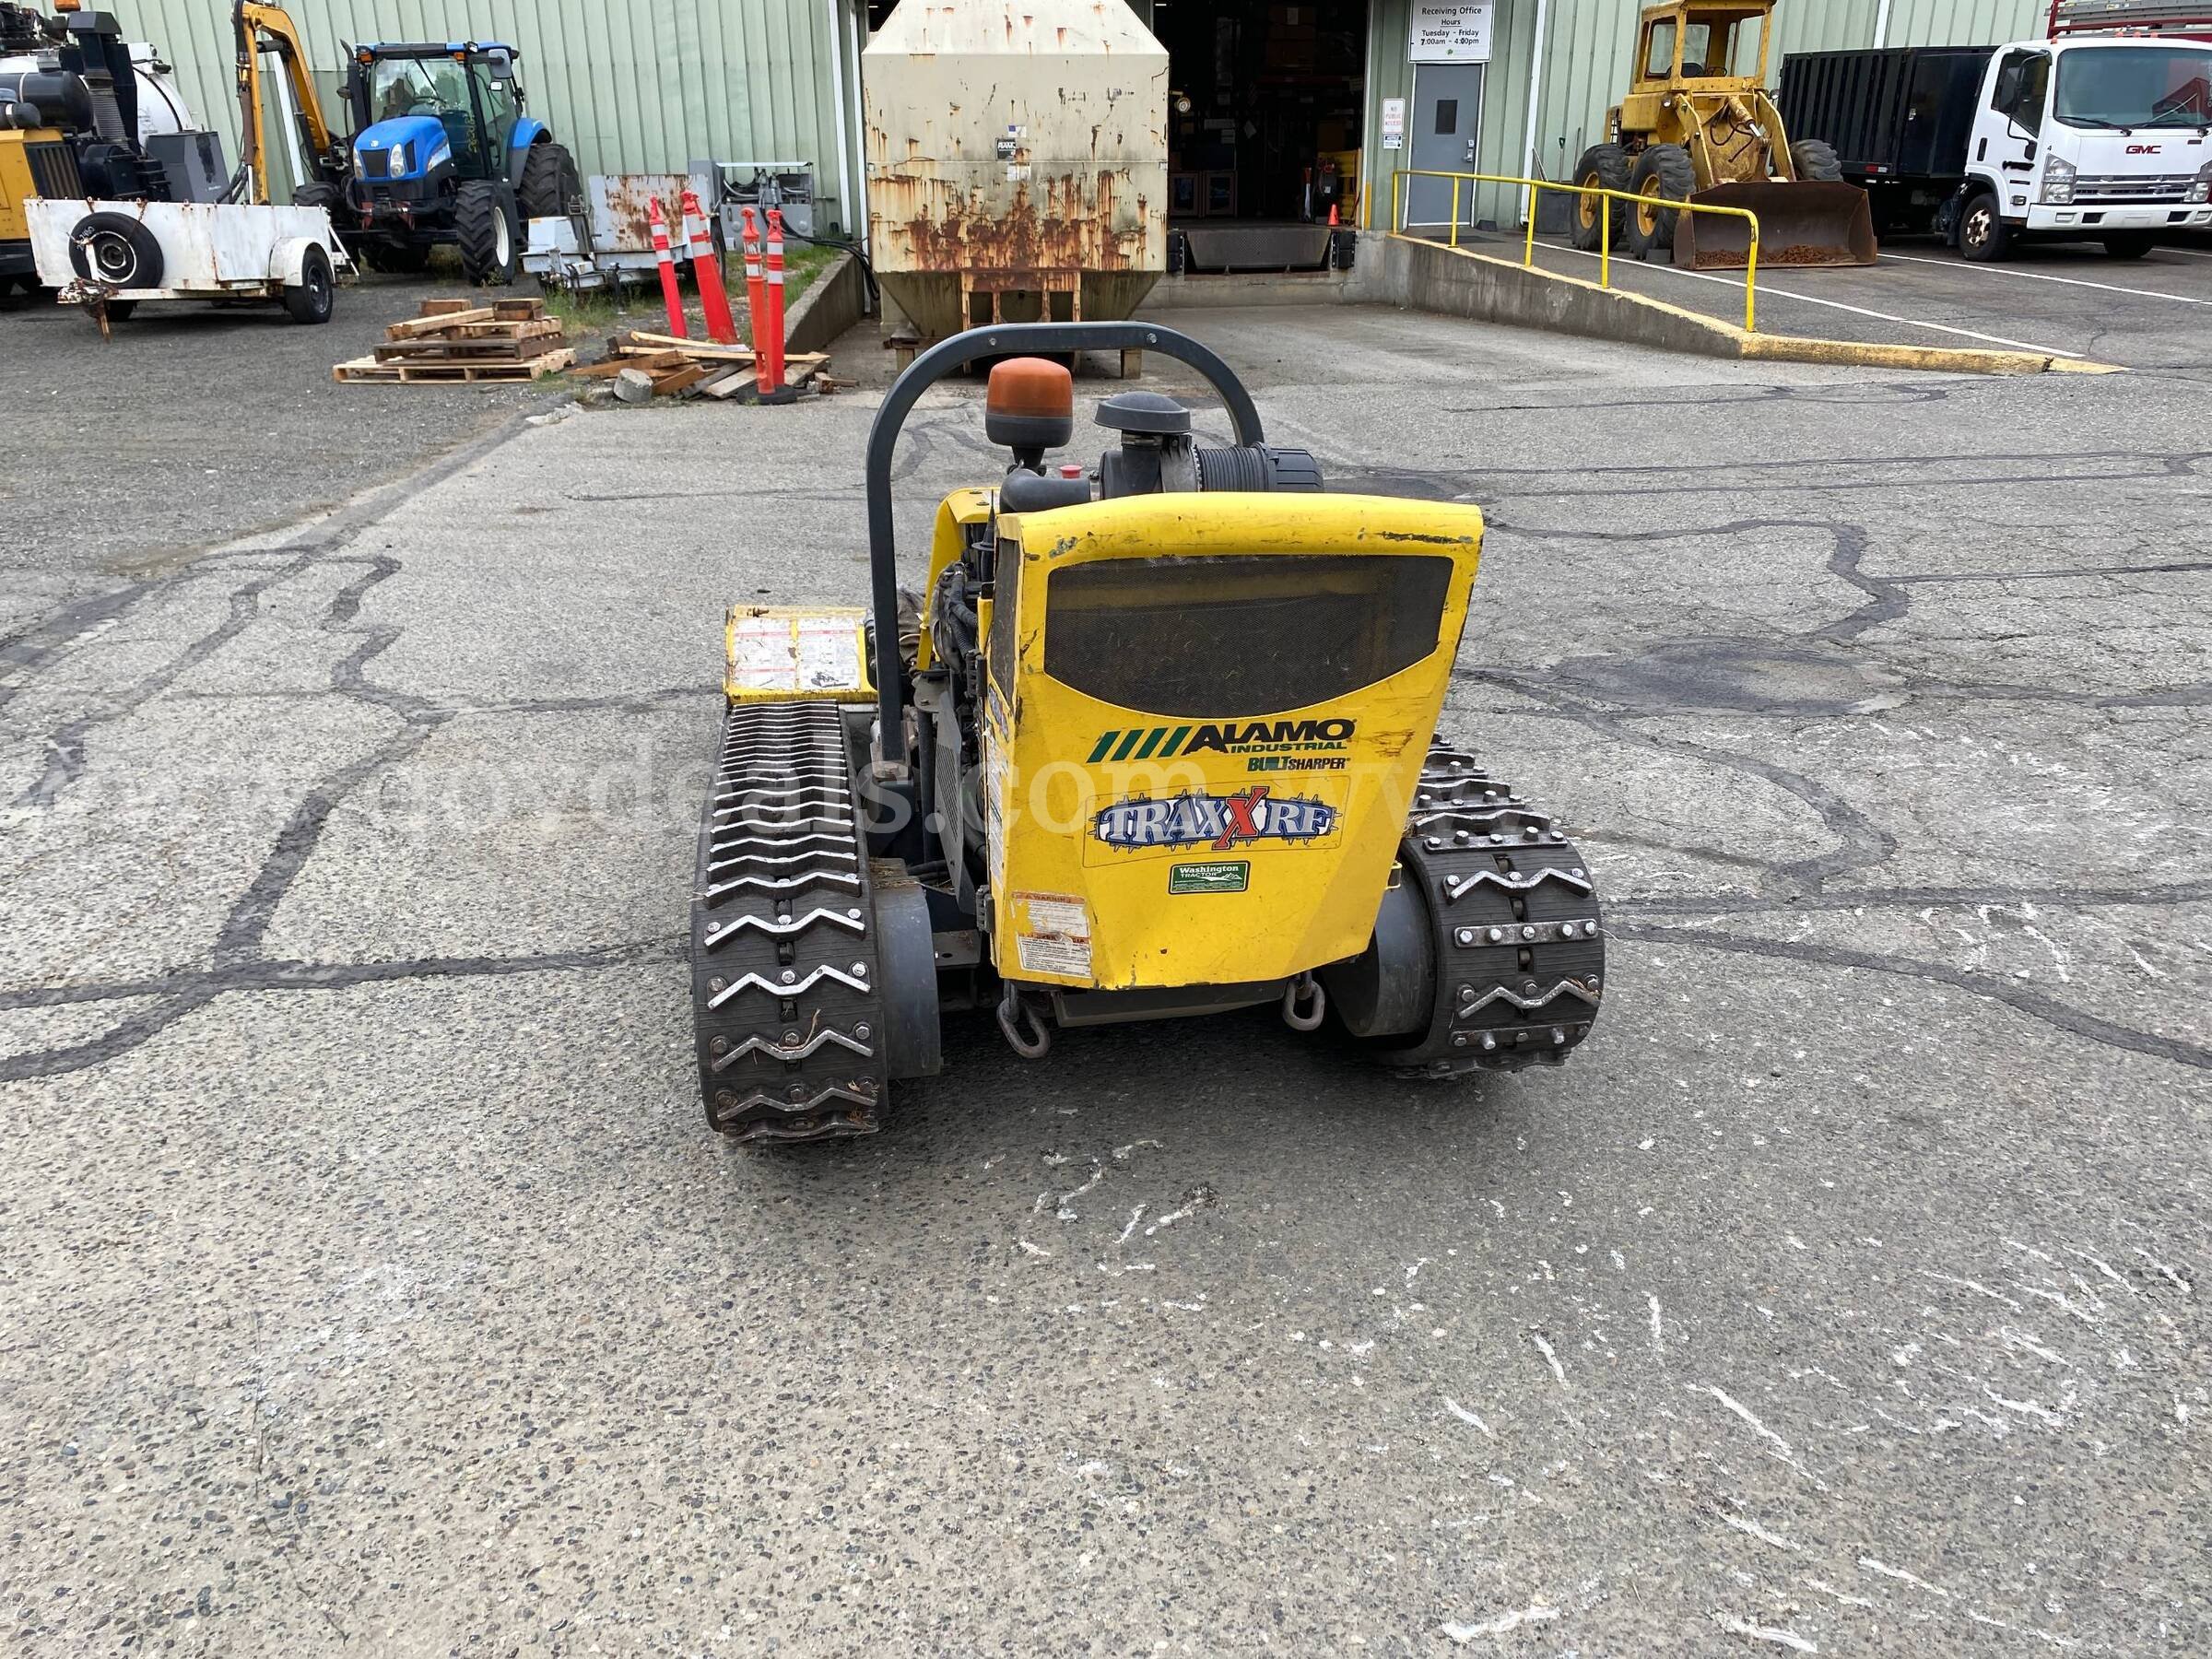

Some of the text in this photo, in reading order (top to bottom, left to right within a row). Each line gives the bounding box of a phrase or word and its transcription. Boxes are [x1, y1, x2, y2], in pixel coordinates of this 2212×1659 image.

[1421, 6, 1482, 16] Receiving Office
[1421, 29, 1450, 38] Tuesday
[1458, 29, 1479, 38] Friday
[2124, 145, 2162, 155] GMC
[1182, 718, 1356, 757] ALAMO
[1230, 740, 1347, 754] INDUSTRIAL
[1179, 865, 1240, 874] Washington
